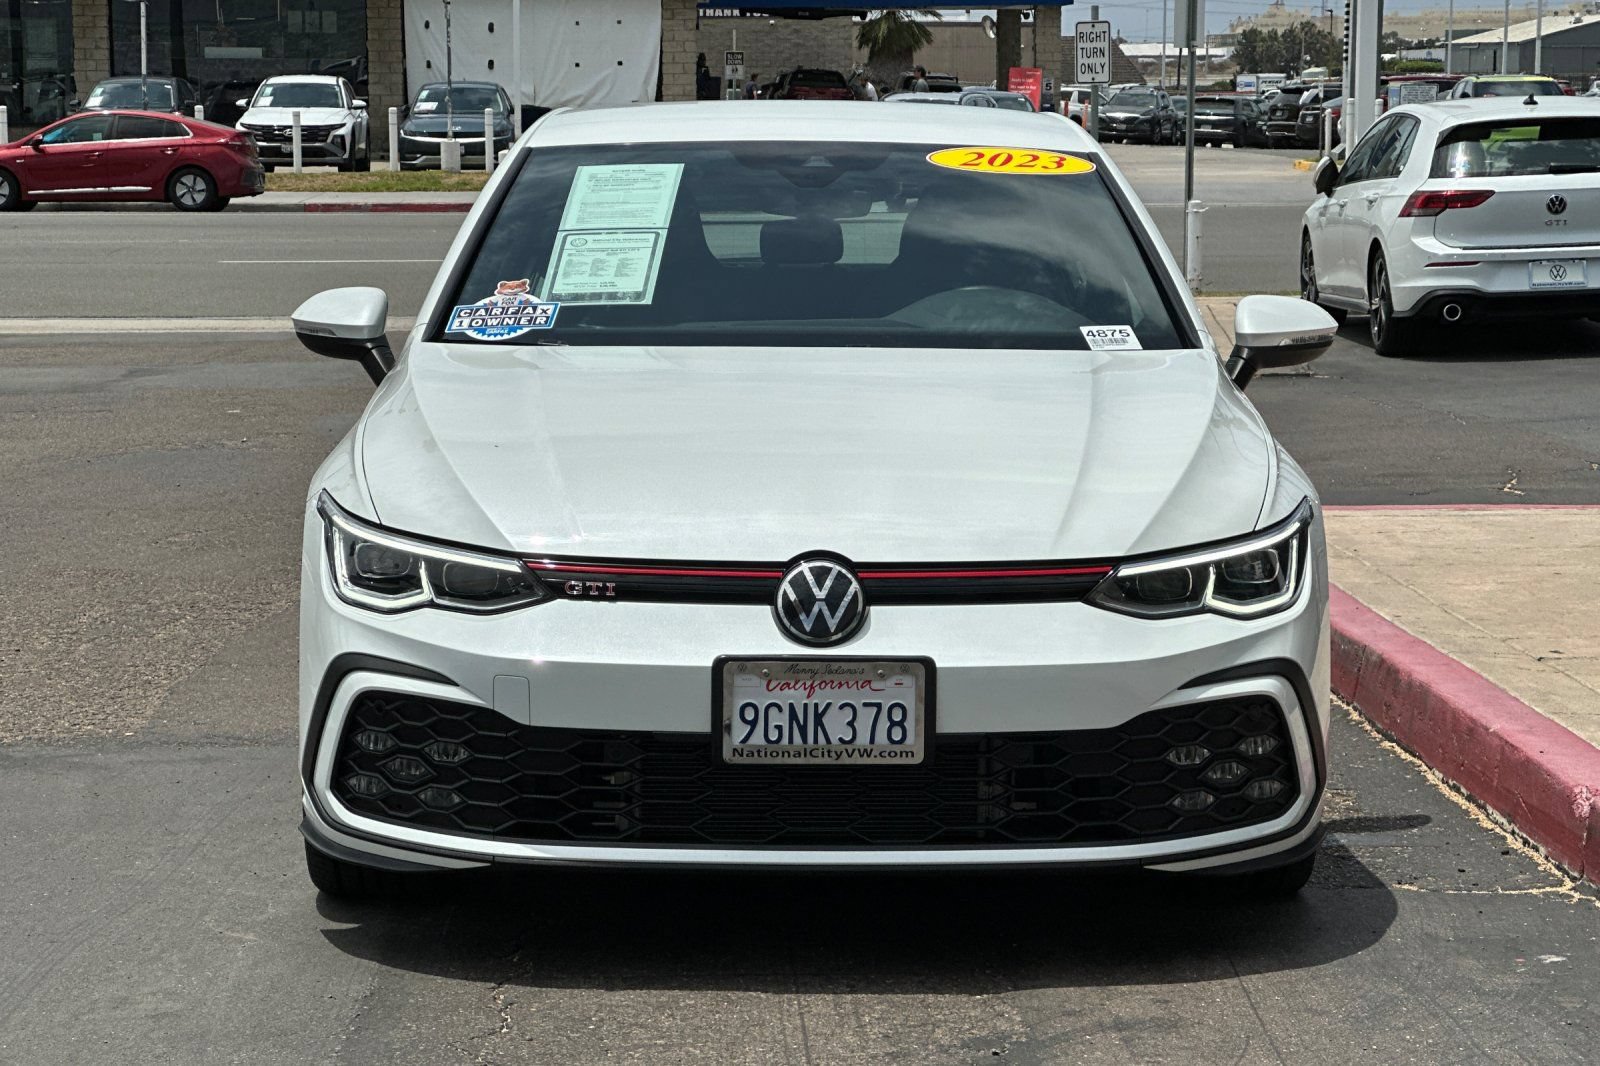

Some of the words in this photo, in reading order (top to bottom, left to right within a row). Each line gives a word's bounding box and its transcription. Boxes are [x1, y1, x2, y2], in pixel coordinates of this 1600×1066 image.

[1079, 31, 1107, 43] RIGHT
[1080, 47, 1105, 58] TURN
[1080, 63, 1106, 74] ONLY
[1045, 82, 1052, 90] 5
[959, 152, 1067, 170] 2023
[460, 304, 551, 318] CARFAX
[456, 318, 466, 328] 1
[471, 316, 547, 328] OWNER
[1086, 328, 1130, 338] 4875
[564, 580, 616, 596] GTI
[738, 701, 908, 745] 9GNK378
[732, 748, 915, 760] NationalCityVW.com
